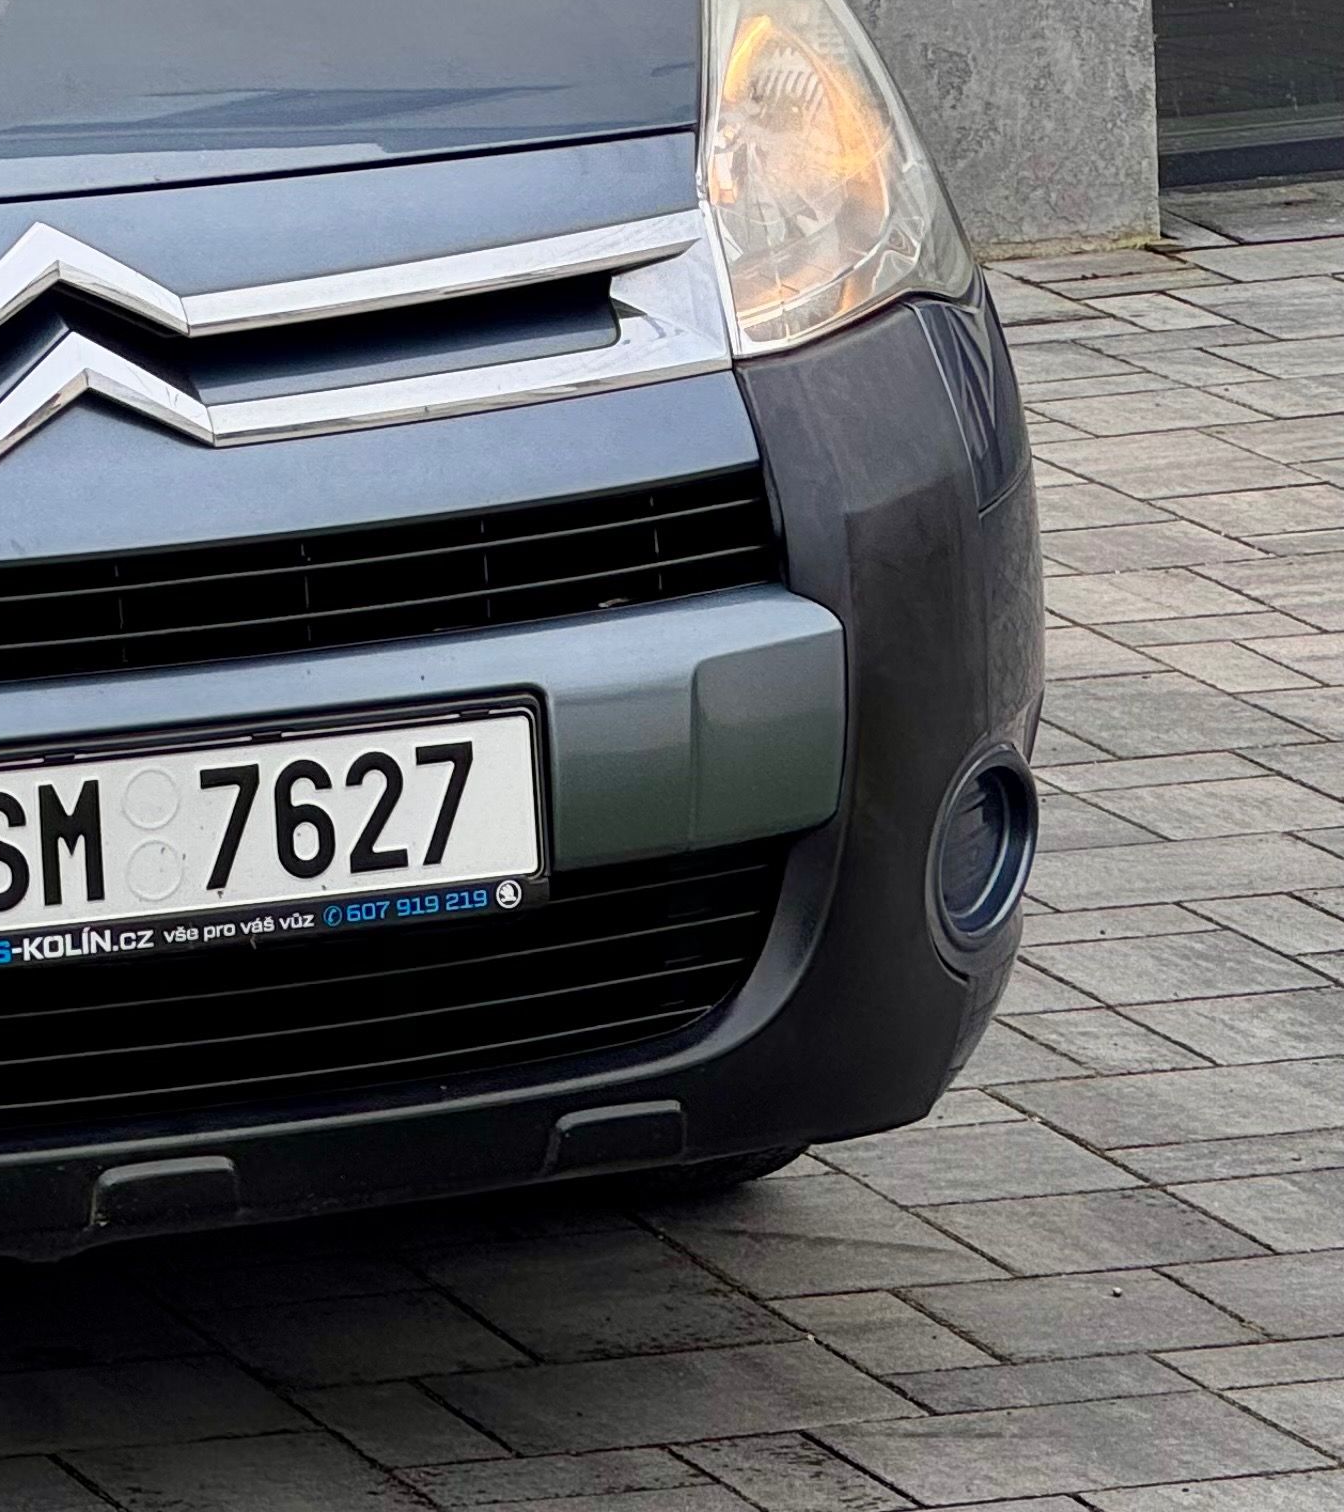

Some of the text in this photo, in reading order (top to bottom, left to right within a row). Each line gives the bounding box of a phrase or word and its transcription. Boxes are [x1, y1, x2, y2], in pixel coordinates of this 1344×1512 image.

[199, 740, 474, 891] 7627
[162, 925, 200, 943] vše
[202, 924, 237, 942] pro
[239, 916, 276, 935] váš
[278, 912, 315, 930] vůz
[345, 900, 391, 923] 607
[396, 895, 440, 917] 919
[445, 889, 488, 912] 219
